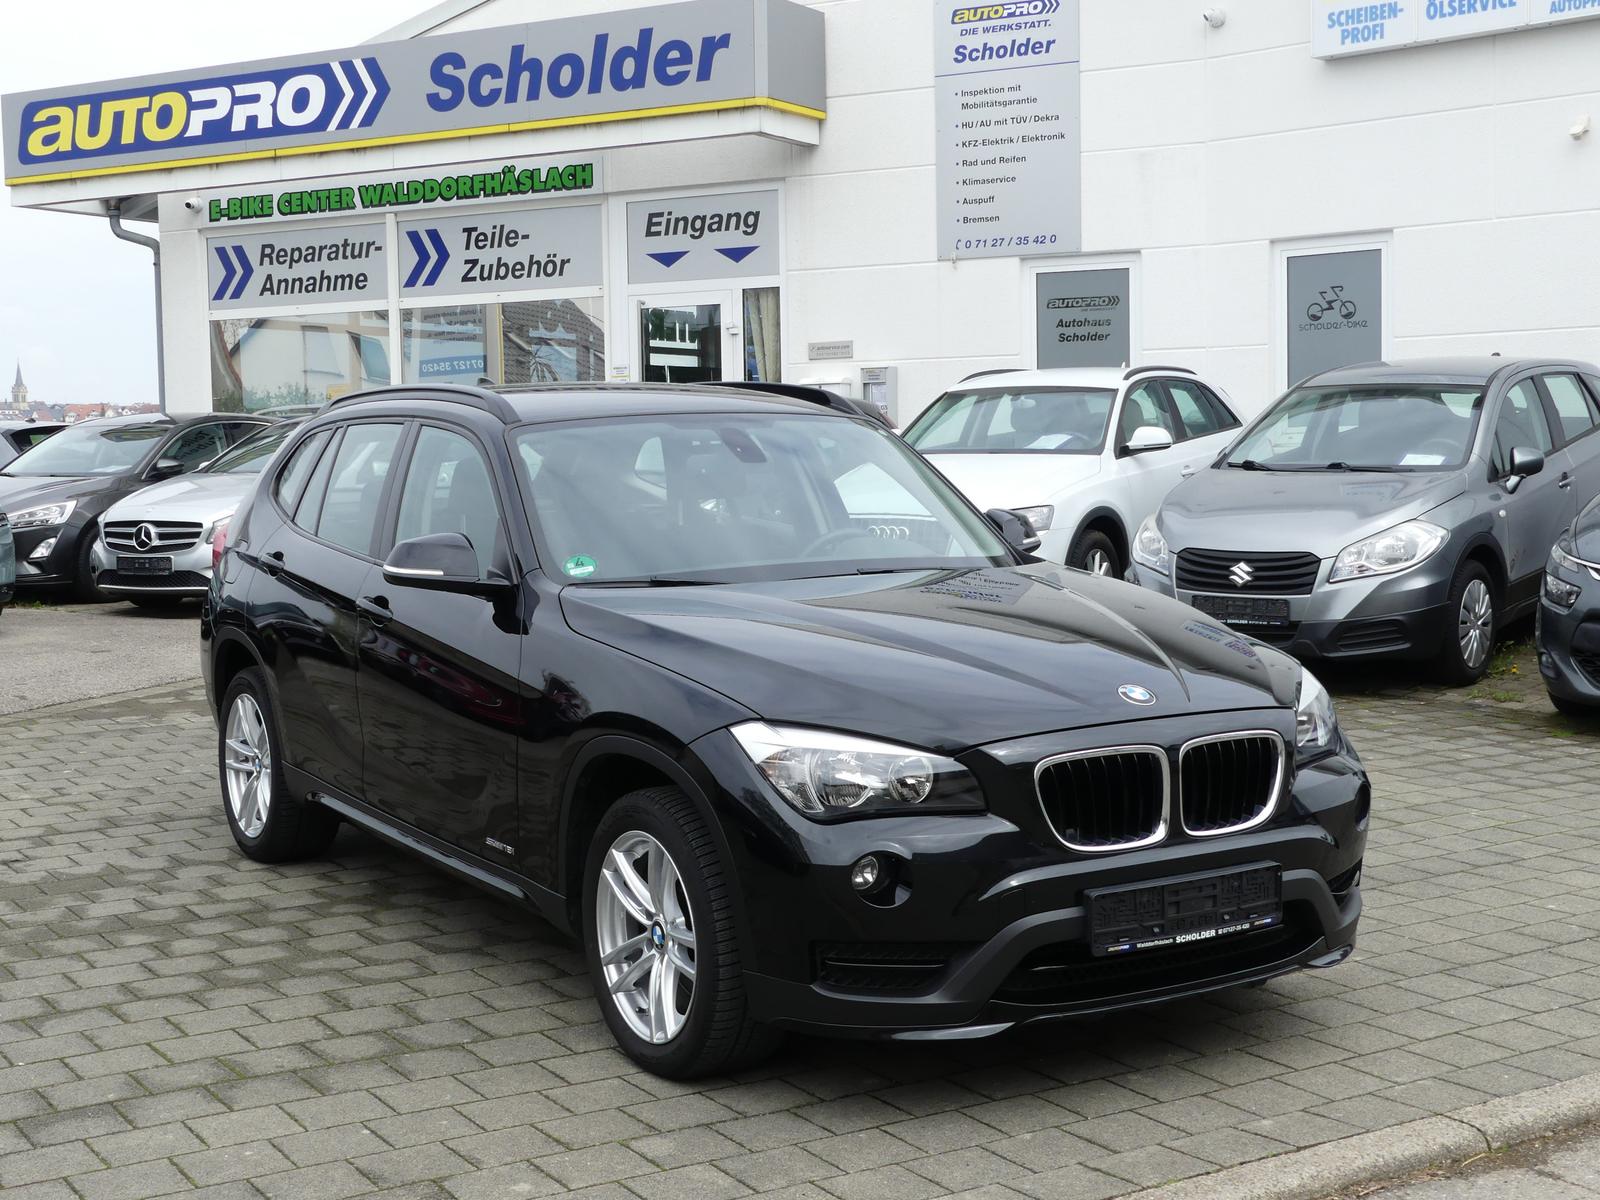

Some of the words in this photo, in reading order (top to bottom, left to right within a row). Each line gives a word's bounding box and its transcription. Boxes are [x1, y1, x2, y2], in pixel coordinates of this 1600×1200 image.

[1327, 7, 1404, 29] SCHEIBEN-
[960, 28, 979, 36] DIE
[982, 19, 1052, 34] WERKSTATT.
[1340, 23, 1385, 45] PROFI
[953, 38, 1056, 63] Scholder
[426, 27, 730, 112] Scholder
[961, 87, 1005, 98] Inspektion
[1007, 84, 1022, 93] mit
[961, 96, 1038, 111] Mobilitätsgarantie
[994, 118, 1008, 126] mit
[961, 138, 1015, 149] KFZ-Elektrik
[1021, 132, 1066, 143] Elektronik
[961, 160, 978, 168] Rad
[980, 158, 997, 166] und
[999, 155, 1027, 165] Reifen
[962, 175, 1017, 187] Klimaservice
[209, 196, 274, 222] E-BIKE
[277, 187, 356, 215] CENTER
[359, 163, 593, 208] WALDDORFHÄSLACH
[962, 195, 995, 207] Auspuff
[645, 210, 761, 238] Eingang
[962, 215, 1000, 225] Bremsen
[461, 225, 531, 252] Teile-
[975, 239, 987, 248] 71
[990, 238, 1005, 247] 27
[1015, 236, 1029, 246] 35
[1032, 236, 1046, 244] 42
[259, 240, 383, 270] Reparatur-
[460, 254, 571, 283] Zubehör
[259, 271, 369, 296] Annahme
[1056, 318, 1111, 328] Autohaus
[1057, 331, 1110, 342] Scholder
[1175, 929, 1216, 943] SCHOLDER
